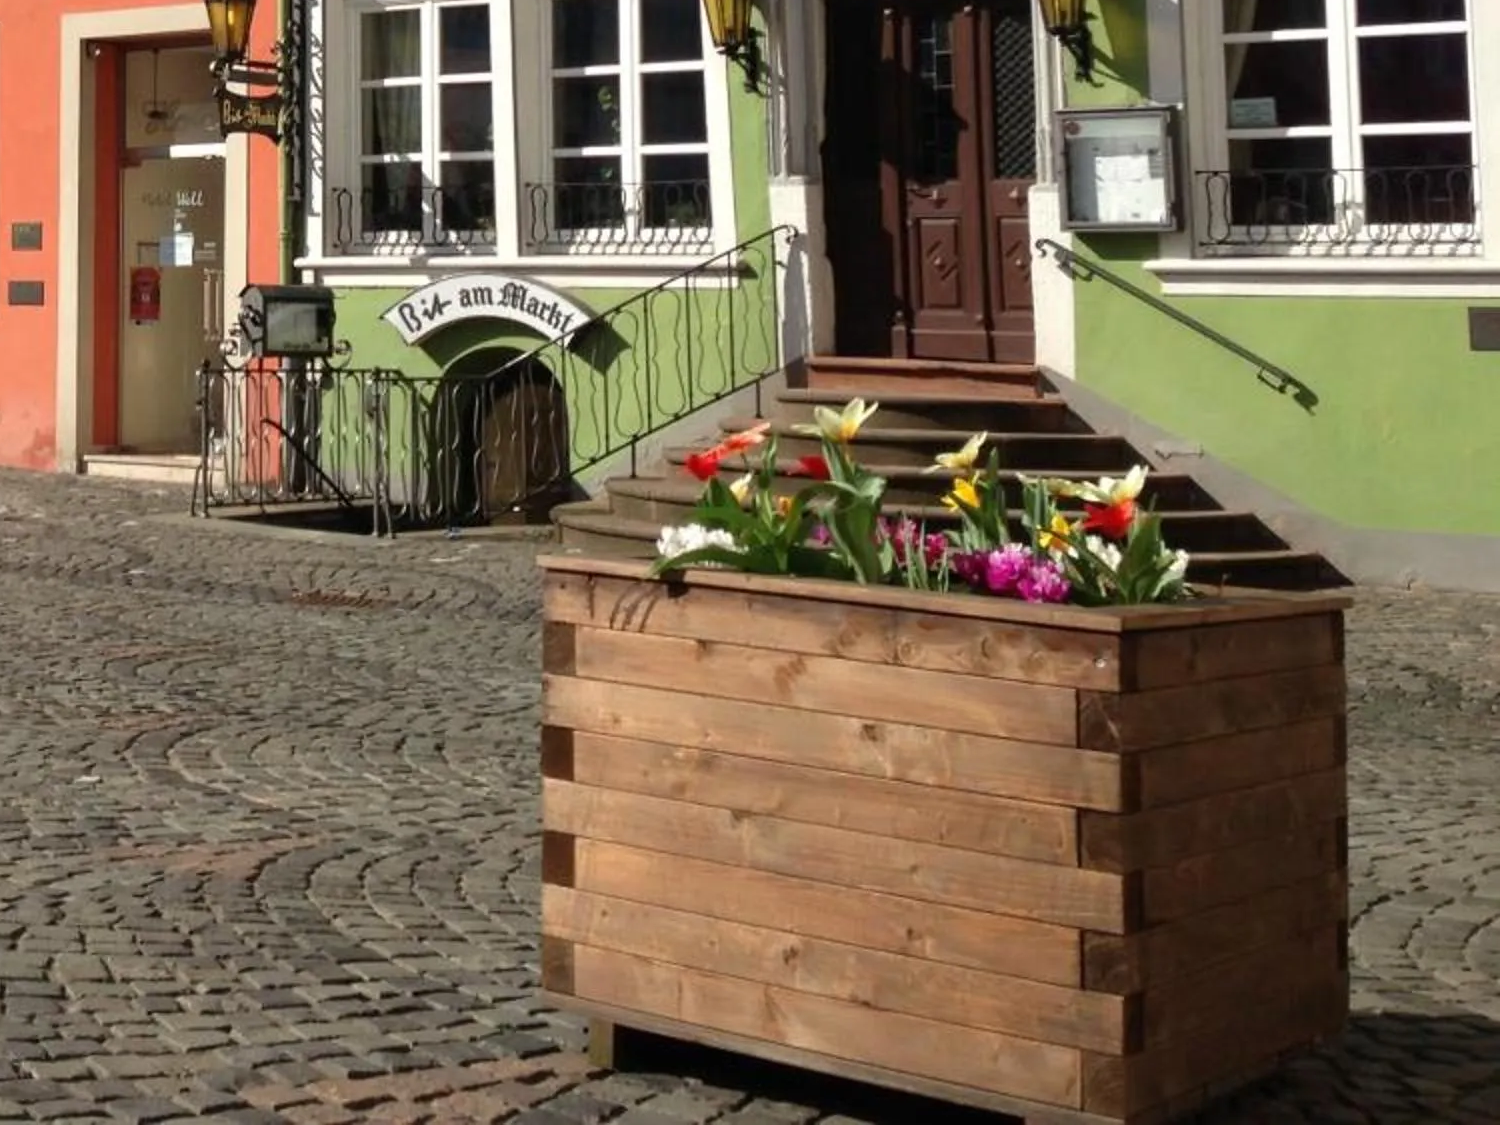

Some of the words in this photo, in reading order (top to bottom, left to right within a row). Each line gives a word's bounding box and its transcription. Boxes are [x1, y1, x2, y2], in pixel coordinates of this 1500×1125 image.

[398, 291, 452, 334] Bit
[457, 285, 493, 308] am
[497, 281, 575, 334] Markt
